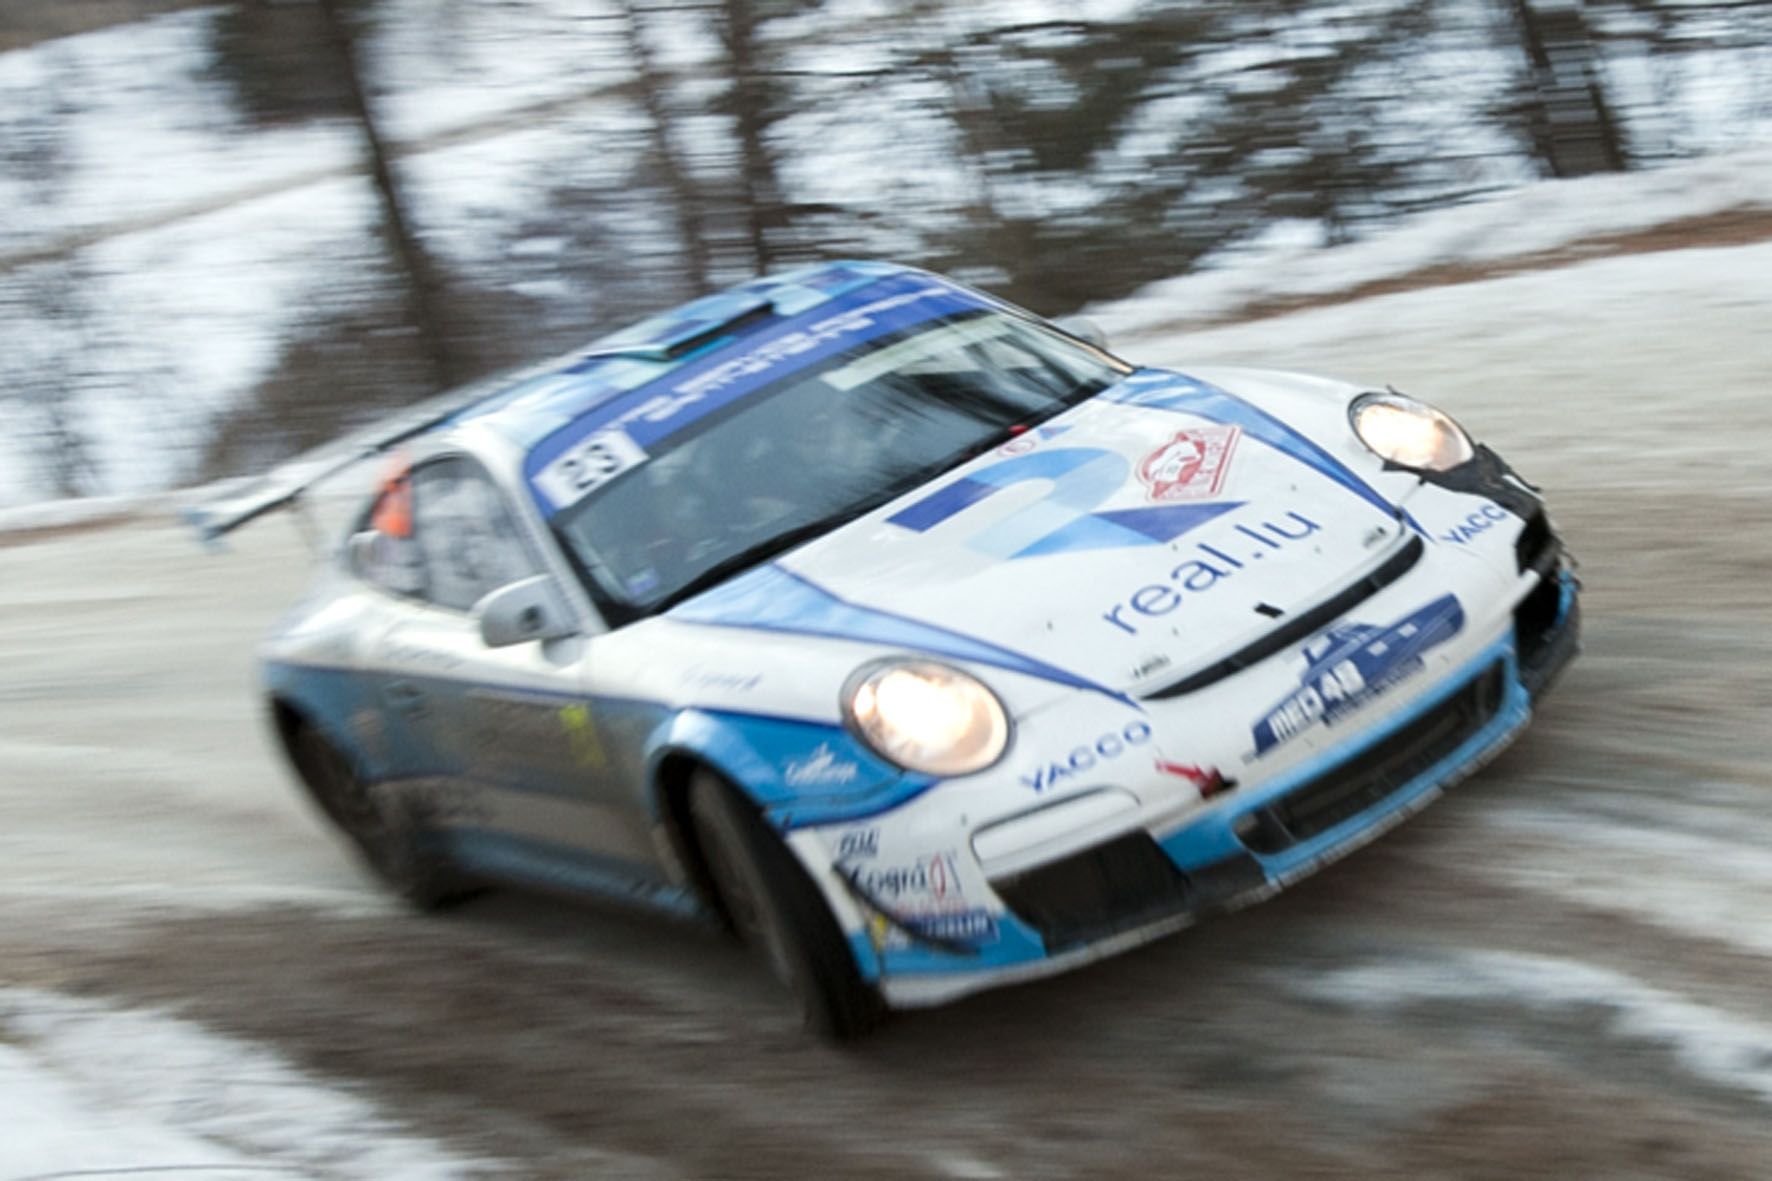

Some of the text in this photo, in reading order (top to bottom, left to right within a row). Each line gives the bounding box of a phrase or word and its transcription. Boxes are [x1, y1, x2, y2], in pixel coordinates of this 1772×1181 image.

[1440, 503, 1508, 545] YACC
[1102, 509, 1323, 635] real.lu
[1019, 719, 1152, 794] YACCO
